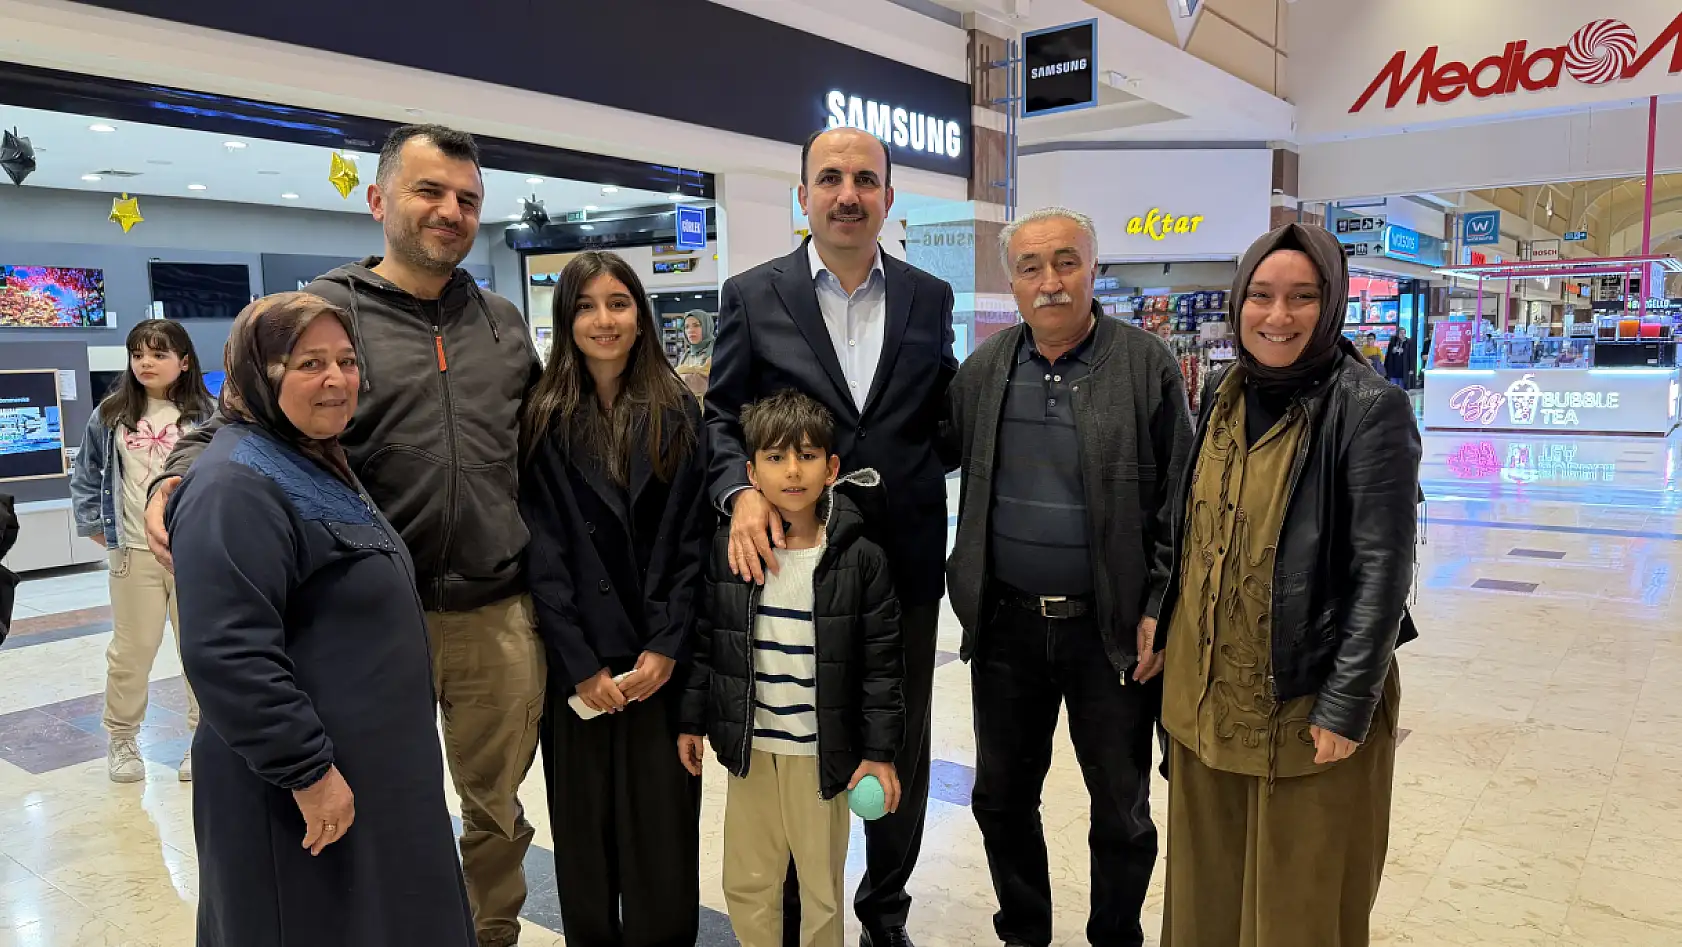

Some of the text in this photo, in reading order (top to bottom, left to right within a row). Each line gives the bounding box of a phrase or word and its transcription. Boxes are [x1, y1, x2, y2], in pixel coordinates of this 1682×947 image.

[1031, 58, 1087, 79] SAMSUNG
[1348, 40, 1566, 113] Media
[828, 89, 961, 157] SAMSUNG
[1126, 207, 1204, 240] aktar
[1450, 385, 1505, 425] Big
[1541, 392, 1620, 409] BUBBLE
[1540, 409, 1579, 426] TEA
